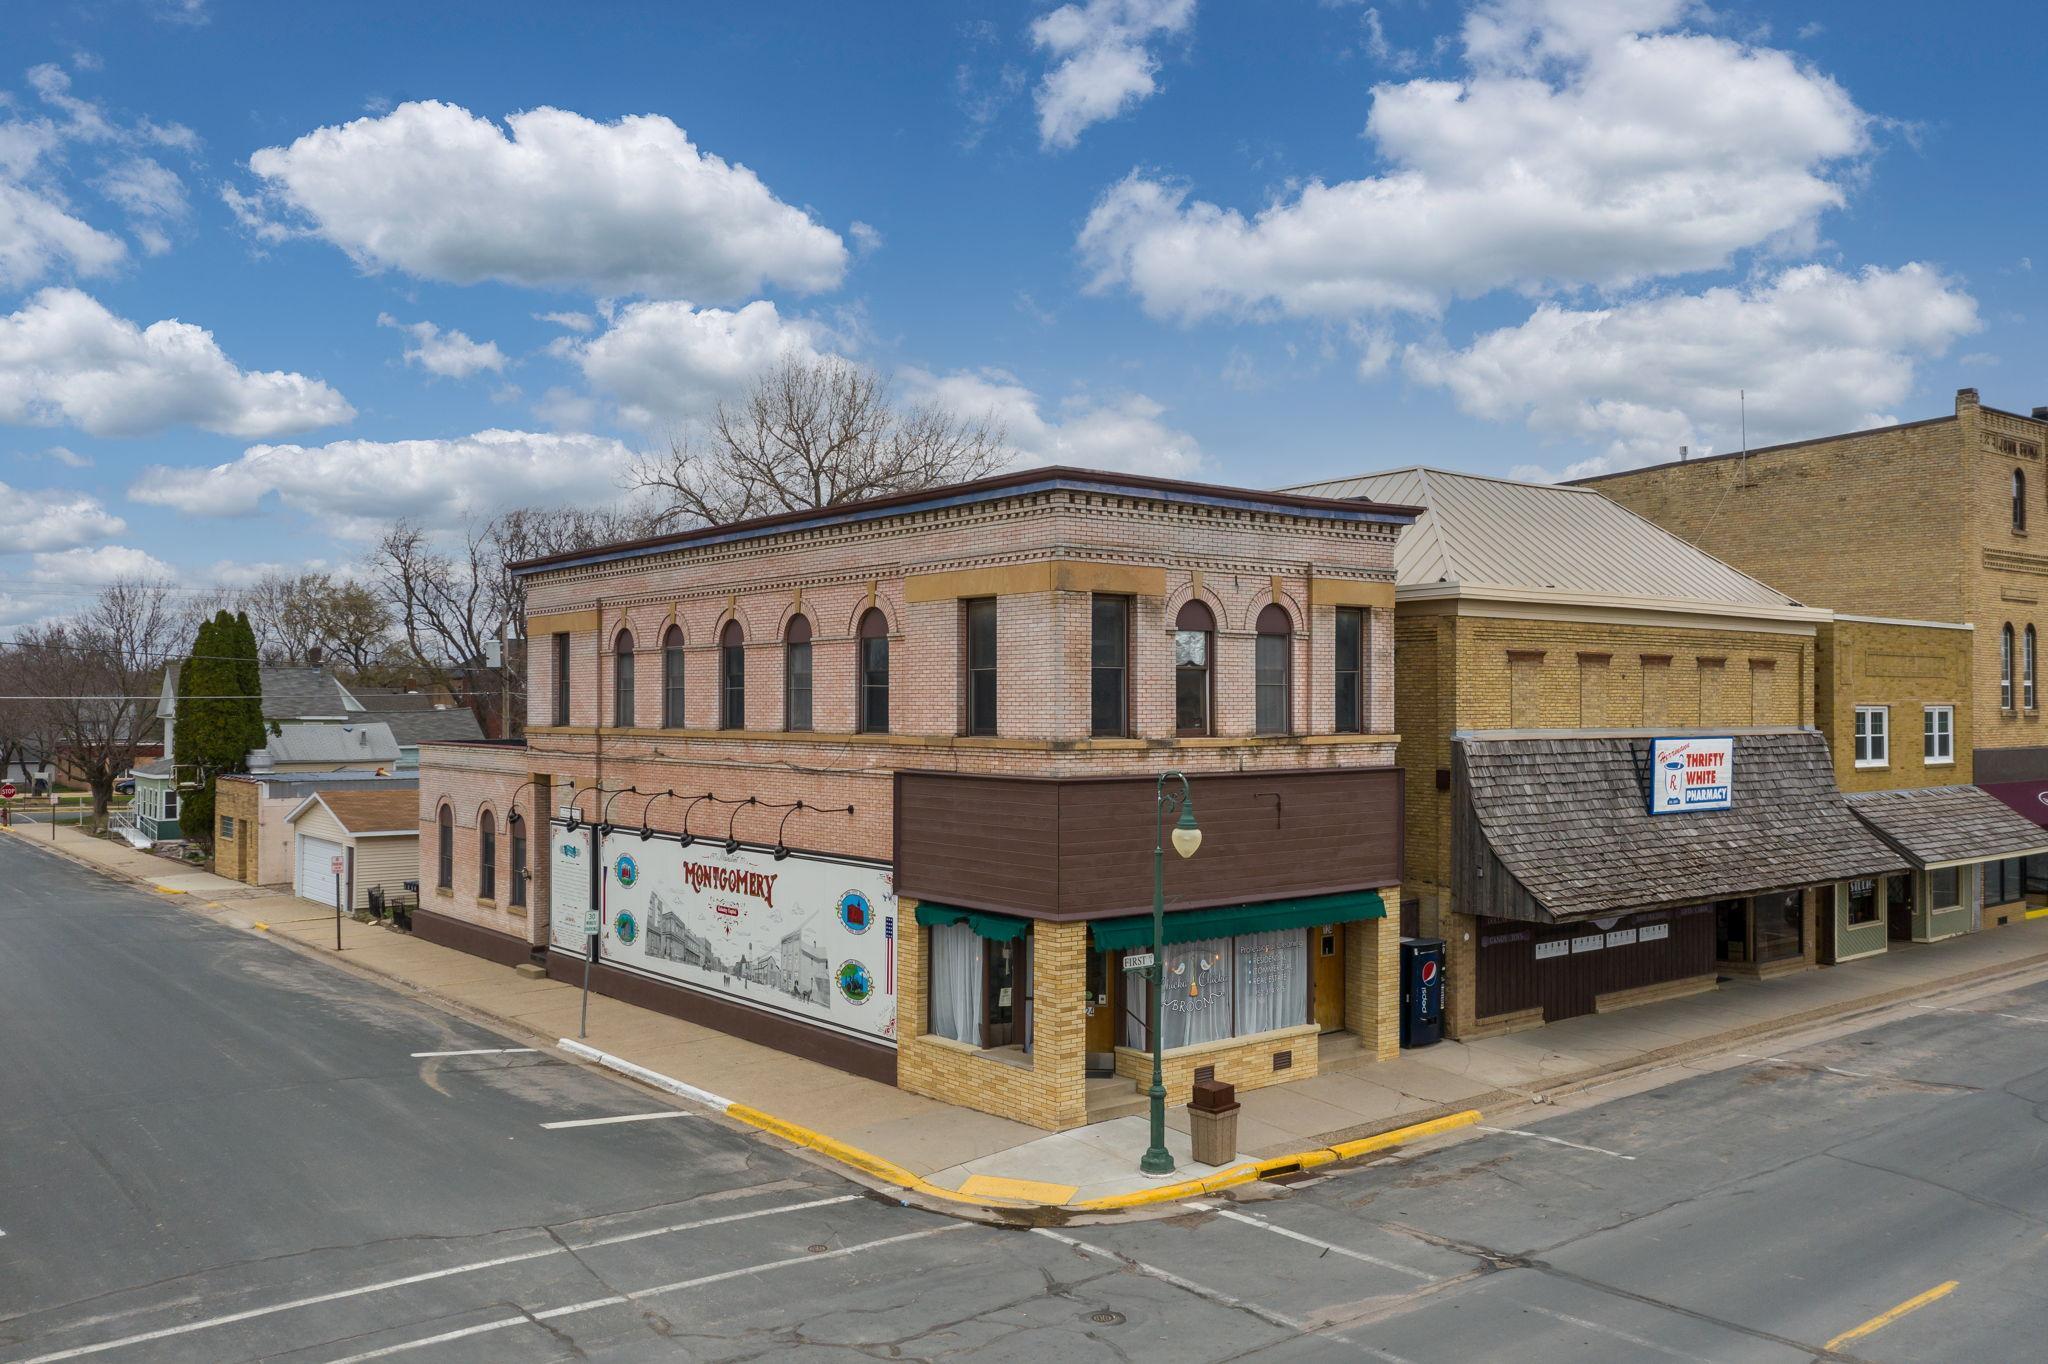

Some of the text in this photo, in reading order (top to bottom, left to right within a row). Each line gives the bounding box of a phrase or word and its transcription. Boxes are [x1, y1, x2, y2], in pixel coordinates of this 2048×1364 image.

[1686, 753, 1724, 767] THRIFTY
[1686, 770, 1716, 785] WHITE
[1686, 788, 1727, 801] PHARMACY
[683, 861, 777, 908] MONTGOMERY
[1124, 955, 1146, 967] FIRST
[1171, 995, 1214, 1013] BROOM
